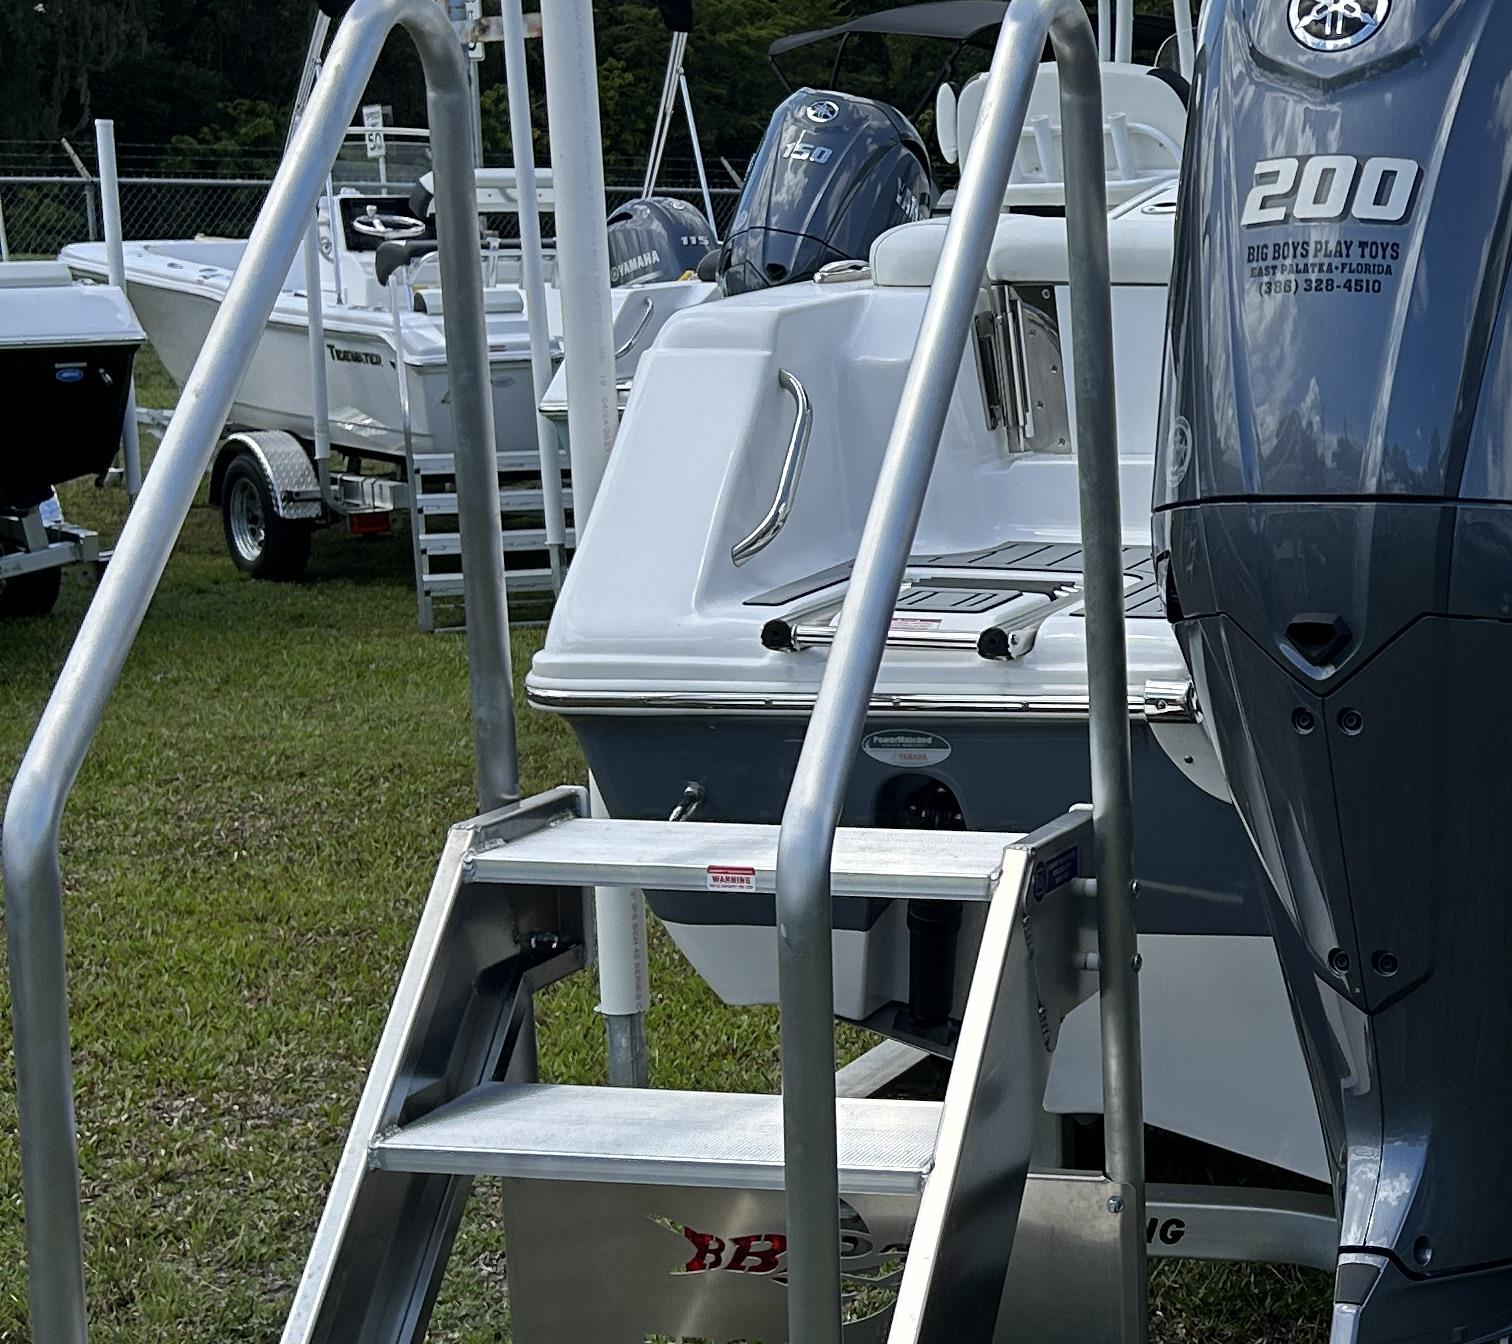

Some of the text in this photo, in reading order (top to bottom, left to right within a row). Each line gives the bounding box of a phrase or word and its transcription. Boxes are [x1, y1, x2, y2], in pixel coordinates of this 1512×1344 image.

[1240, 155, 1424, 228] 200
[681, 236, 710, 246] 115
[1247, 240, 1400, 264] BIG BOYS PLAY TOYS
[617, 250, 661, 277] YAMAHA
[1250, 264, 1279, 278] EAST
[1303, 278, 1382, 294] 328-4510
[711, 875, 752, 885] WARNING
